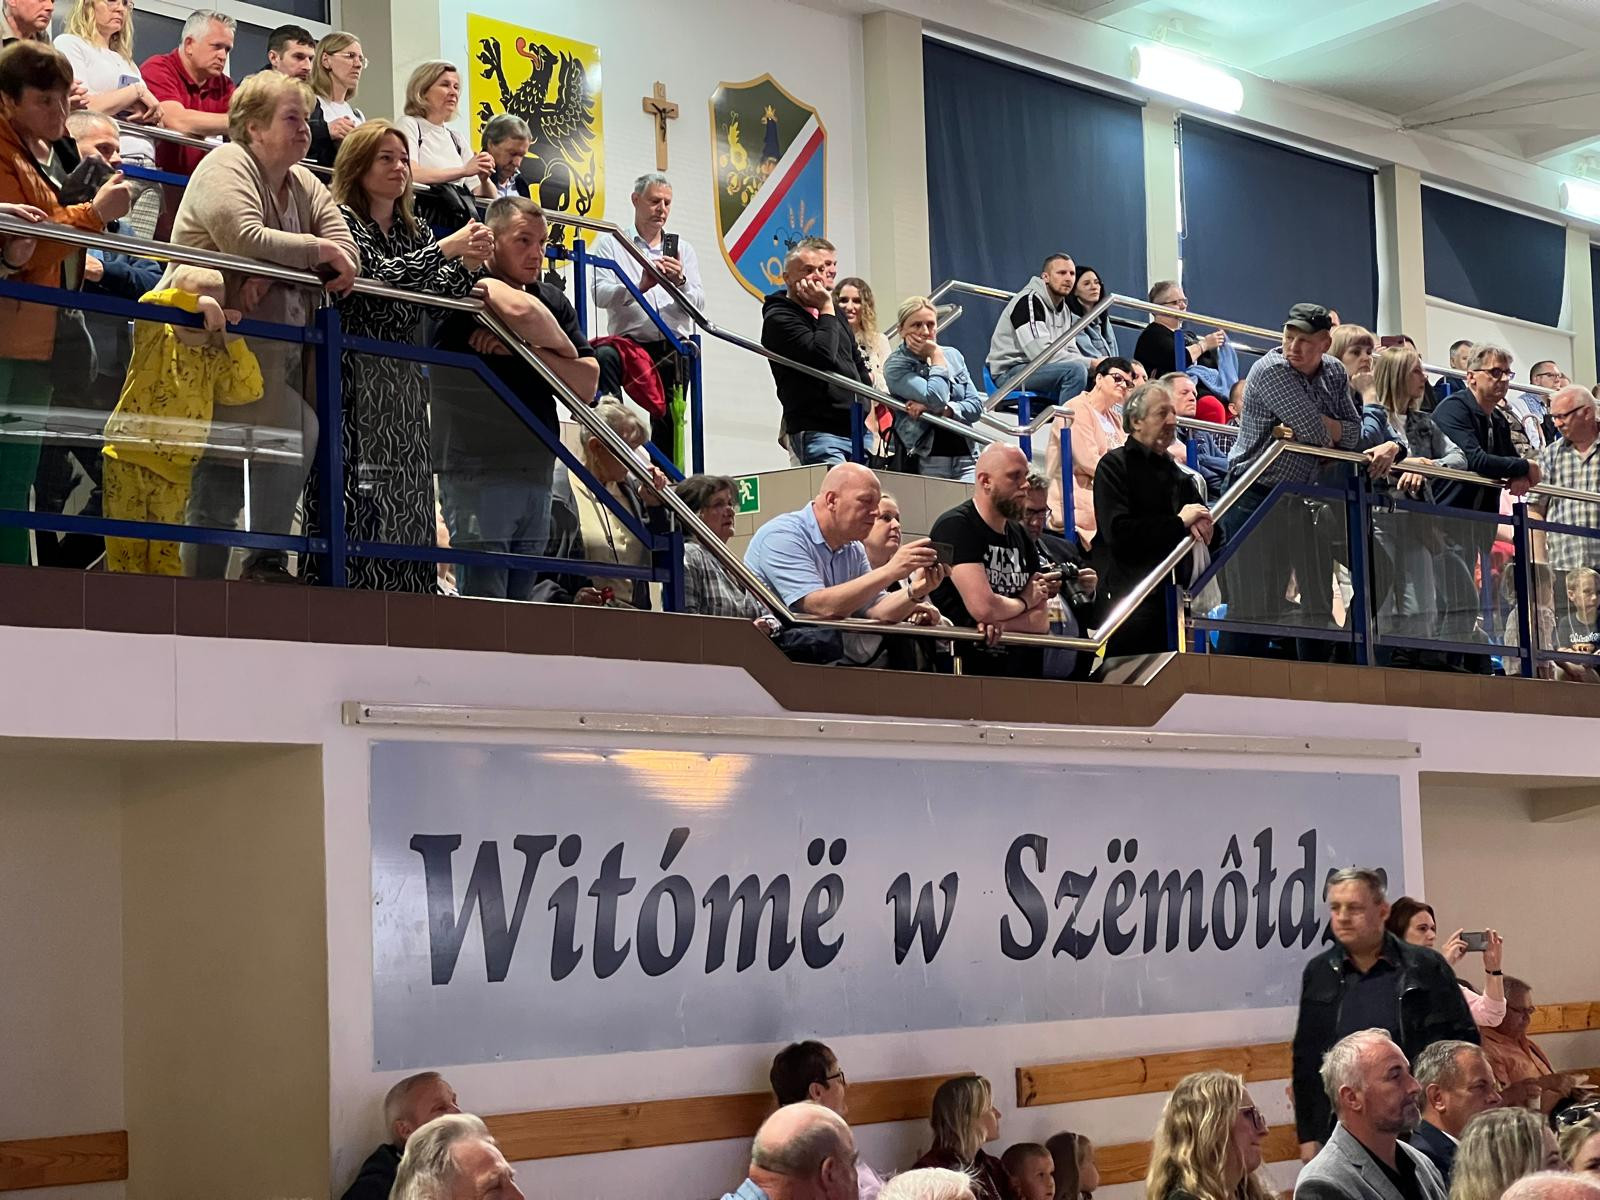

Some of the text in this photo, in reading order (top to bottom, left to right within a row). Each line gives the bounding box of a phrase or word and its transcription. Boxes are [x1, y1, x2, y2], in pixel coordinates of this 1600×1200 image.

[410, 828, 1387, 985] Witómë w Szëmôłd
